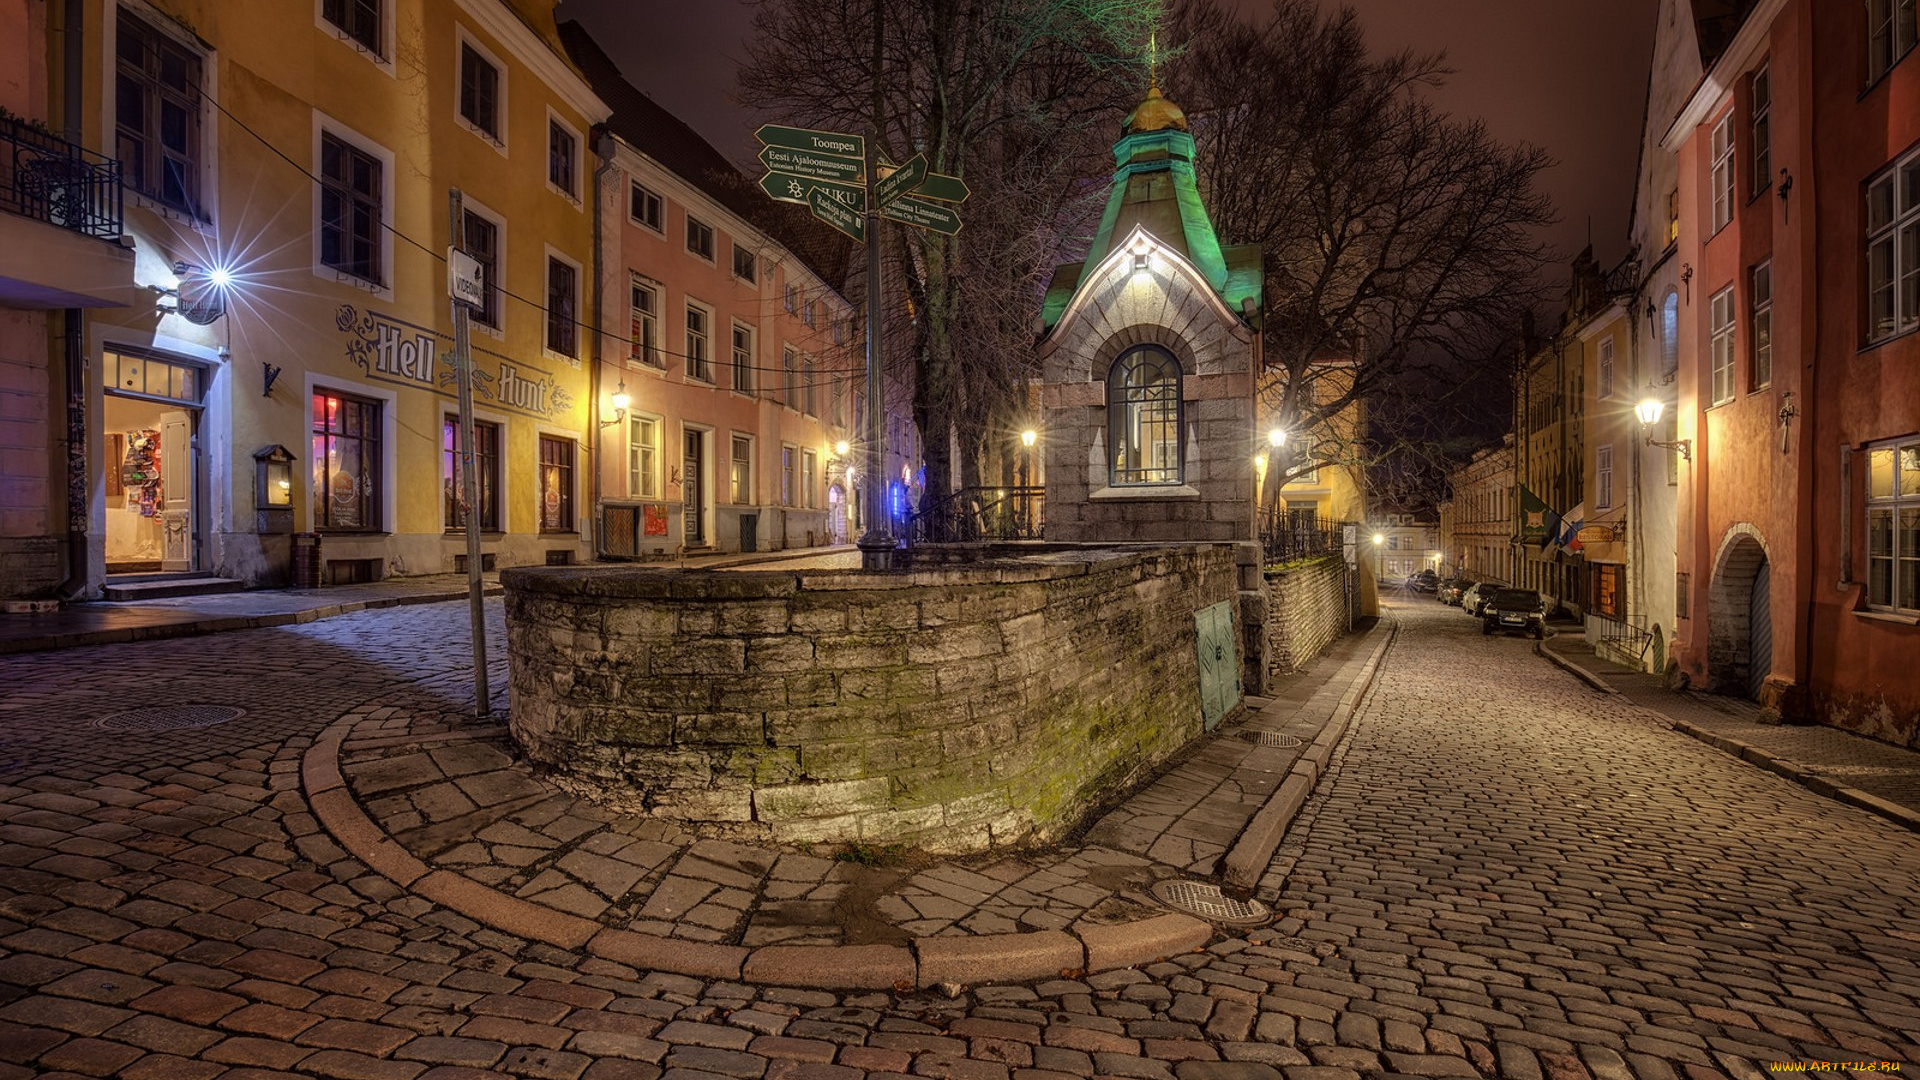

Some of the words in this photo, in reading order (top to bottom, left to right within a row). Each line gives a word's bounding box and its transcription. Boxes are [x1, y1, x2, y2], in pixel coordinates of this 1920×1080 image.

[811, 136, 855, 152] Toompea
[769, 150, 790, 162] Eesti
[792, 154, 858, 172] Ajaloomuuseum
[769, 161, 794, 171] Estonian
[795, 165, 816, 175] History
[816, 168, 841, 177] Museum
[377, 323, 435, 384] Hell
[498, 362, 546, 413] Hunt
